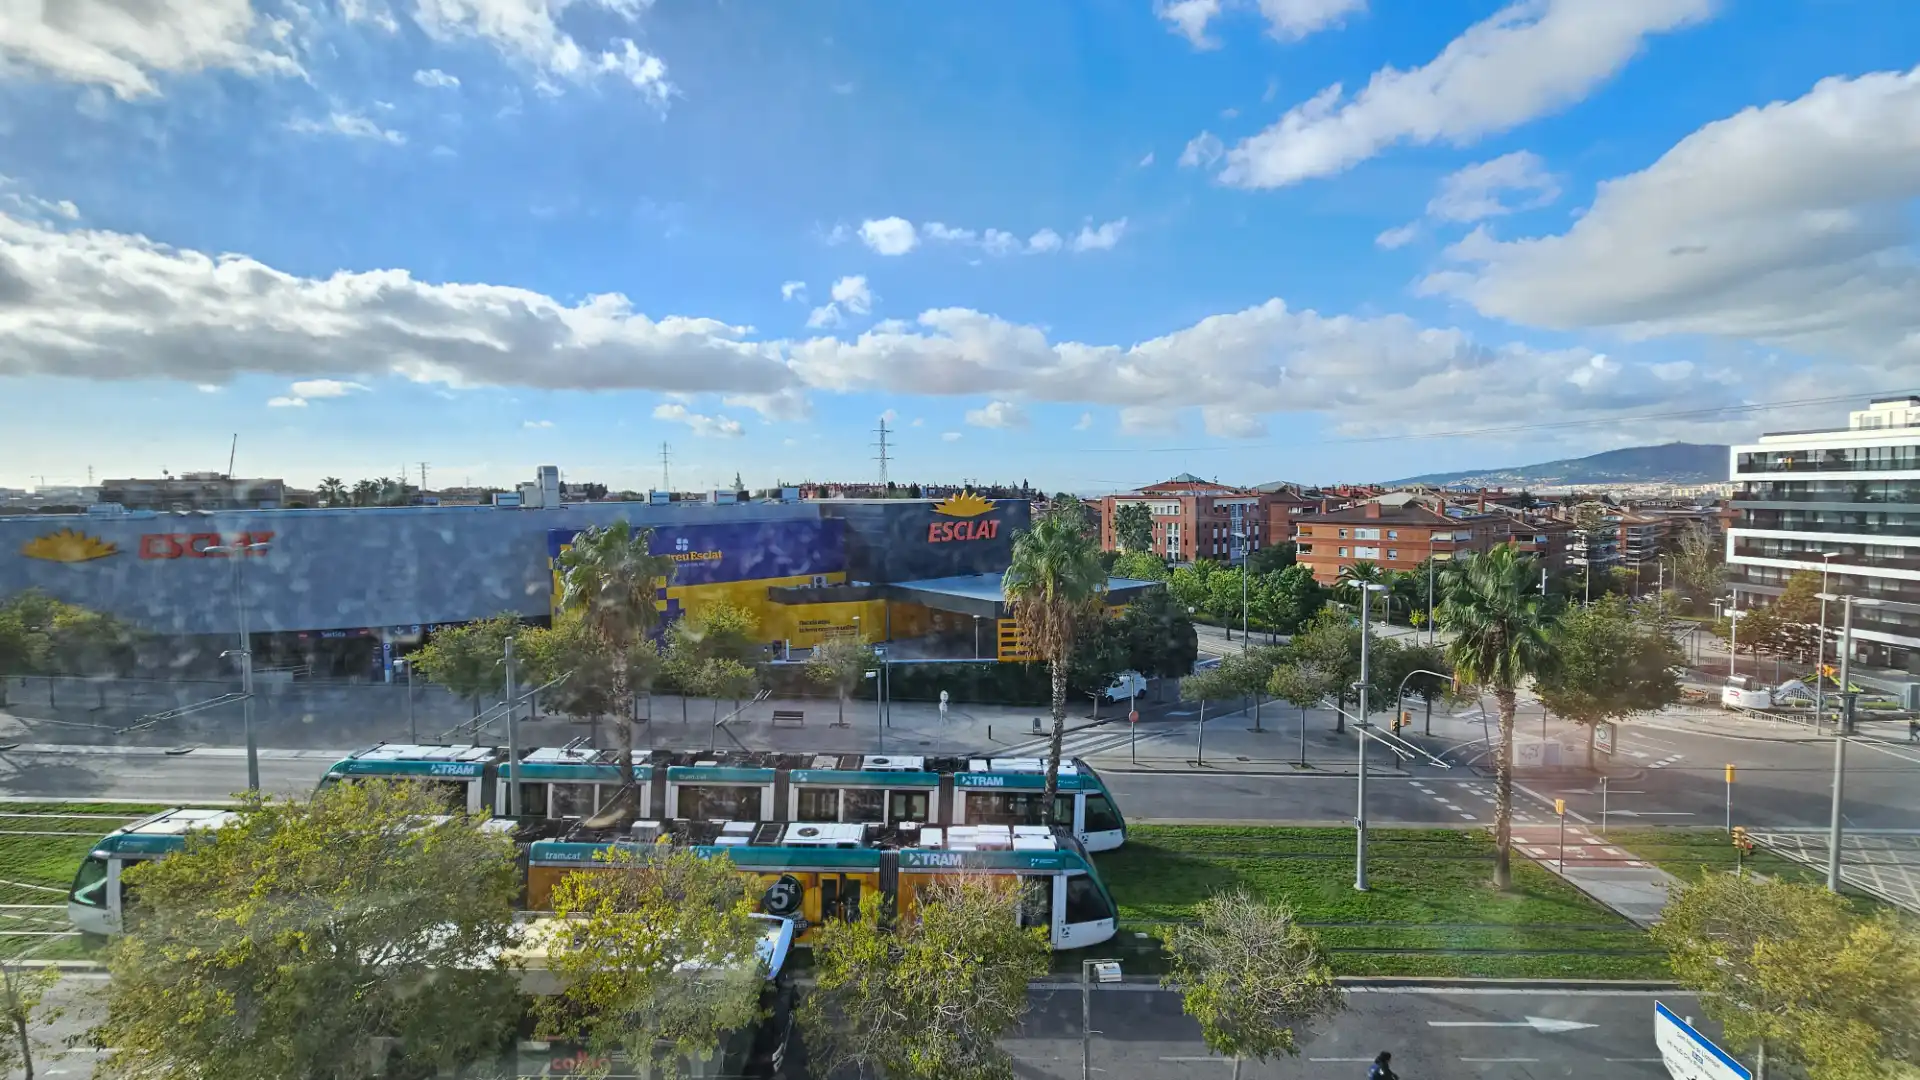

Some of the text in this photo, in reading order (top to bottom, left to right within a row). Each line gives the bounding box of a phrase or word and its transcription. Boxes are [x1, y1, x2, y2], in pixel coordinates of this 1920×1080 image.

[928, 520, 1001, 543] ESCLAT
[138, 531, 276, 560] ESCLAT
[441, 764, 475, 775] TRAM
[972, 776, 1004, 786] TRAM
[545, 852, 580, 860] tram.cat
[922, 852, 962, 866] TRAM
